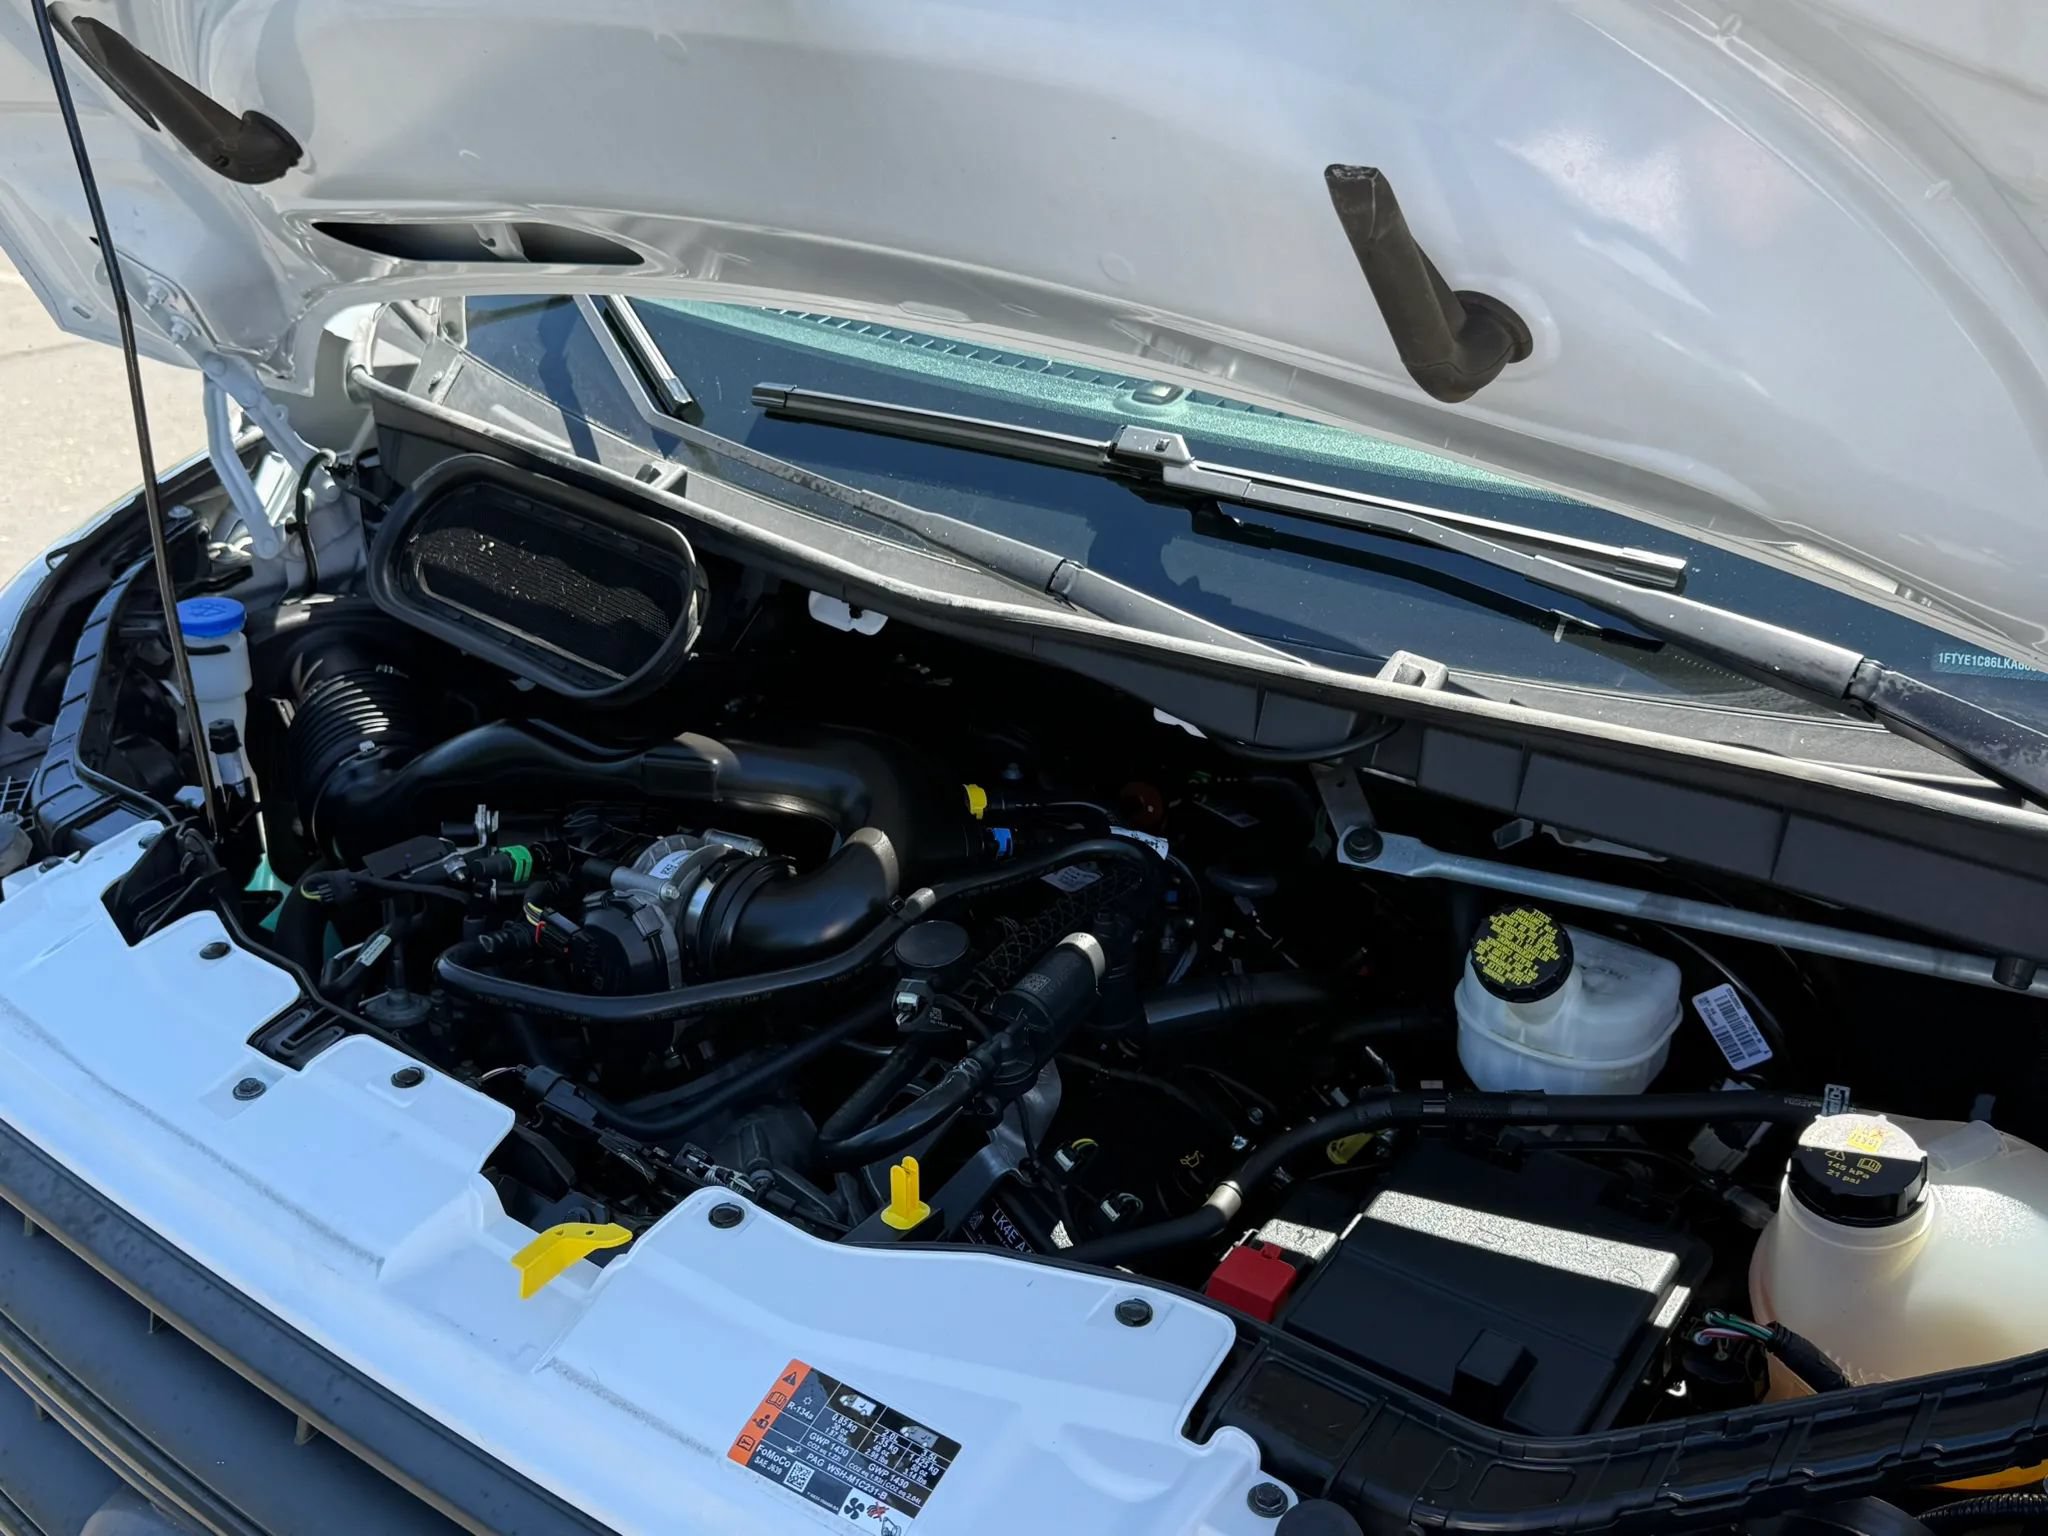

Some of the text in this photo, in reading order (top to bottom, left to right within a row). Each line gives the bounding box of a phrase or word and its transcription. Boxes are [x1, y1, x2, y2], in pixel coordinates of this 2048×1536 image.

[1827, 1160, 1870, 1180] 145 kPa
[1827, 1169, 1861, 1184] 21 psi
[992, 1209, 1019, 1244] LK4E
[787, 1401, 814, 1419] R-134a
[832, 1414, 858, 1433] 0.85 kg
[810, 1432, 849, 1457] GWP 1430
[882, 1429, 898, 1443] 2.0L
[807, 1441, 820, 1450] CO2
[888, 1443, 899, 1454] kg
[756, 1444, 791, 1467] FoMoCo
[921, 1449, 938, 1463] 3.5L
[754, 1456, 782, 1475] SAE J639
[849, 1463, 862, 1472] CO2
[928, 1464, 939, 1476] kg
[806, 1453, 887, 1499] PAG WSH-M1C231-B
[868, 1463, 909, 1488] GWP 1430
[885, 1482, 899, 1492] CO2
